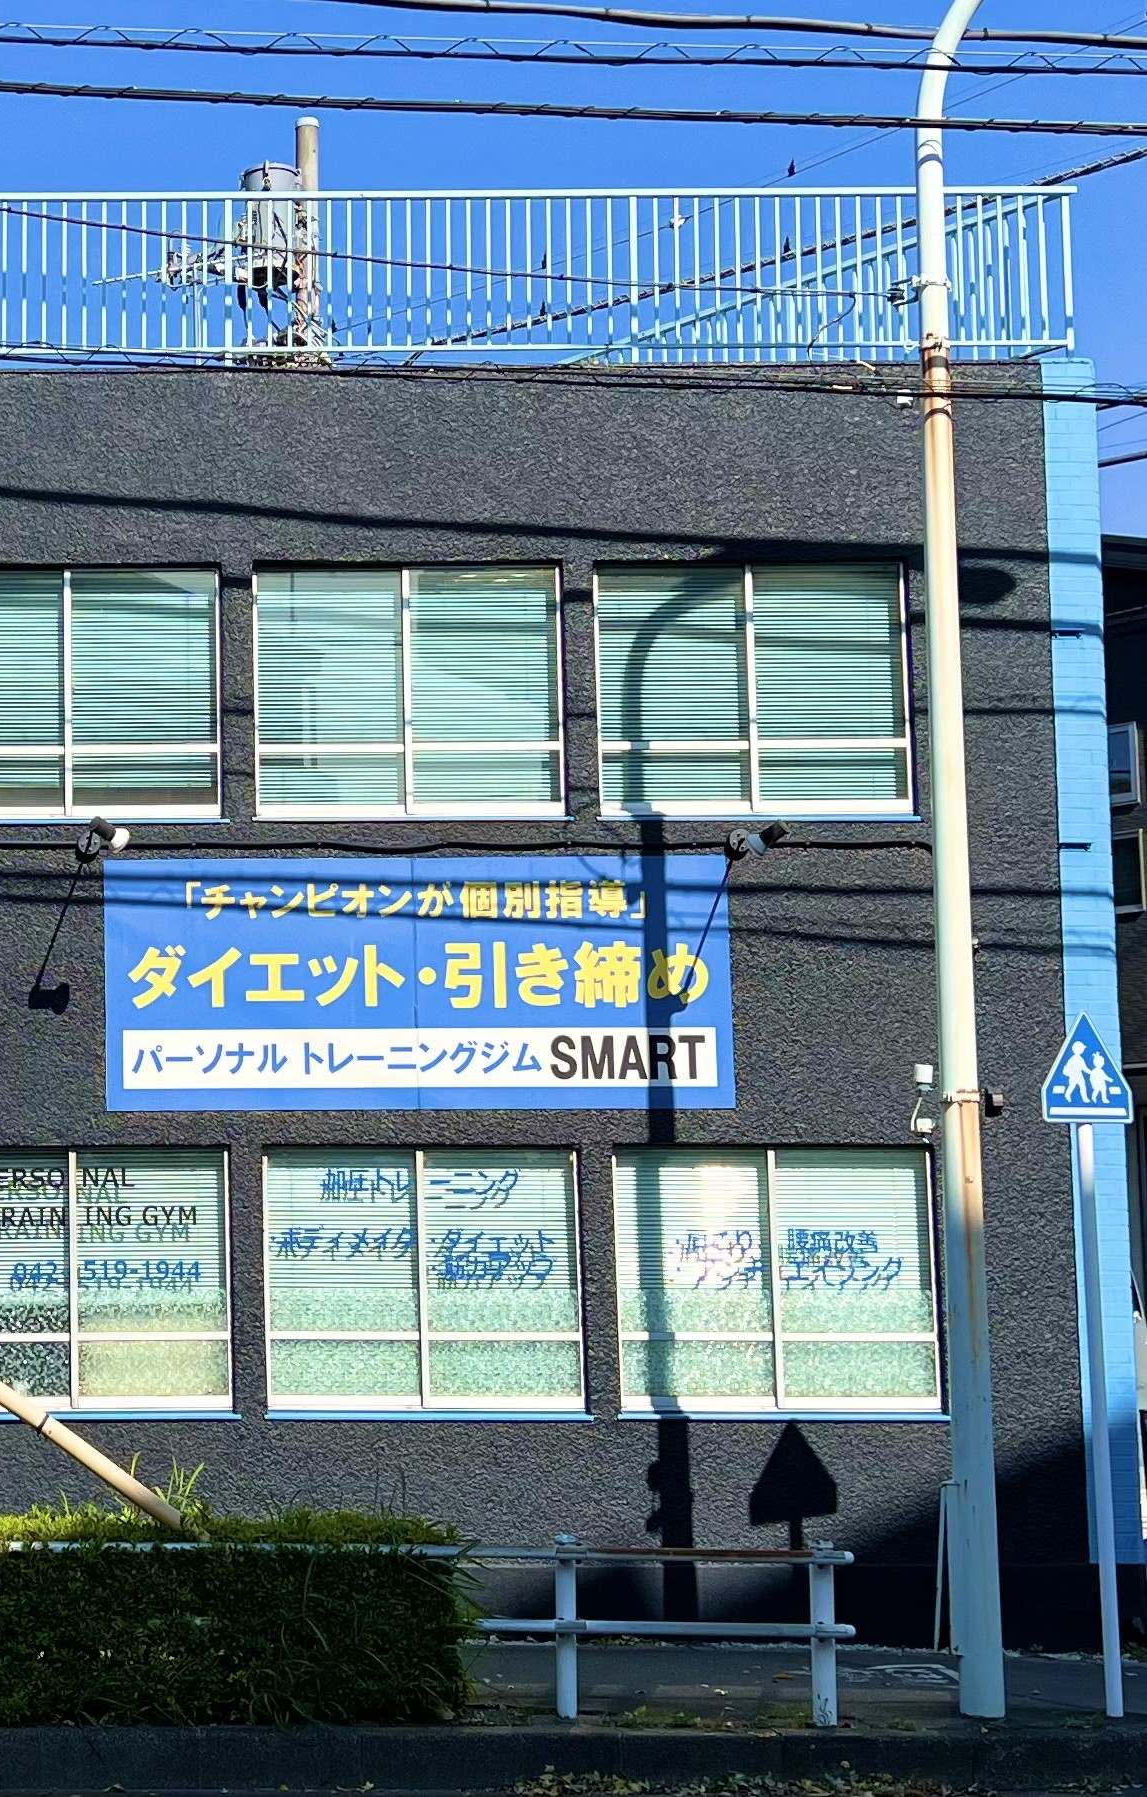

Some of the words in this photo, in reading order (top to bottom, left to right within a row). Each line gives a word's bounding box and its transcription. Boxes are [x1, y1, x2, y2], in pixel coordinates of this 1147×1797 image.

[127, 940, 709, 1010] ダイエット・引き締め
[131, 1042, 289, 1076] パーソナル
[550, 1034, 706, 1081] SMART
[142, 1205, 197, 1226] GYM
